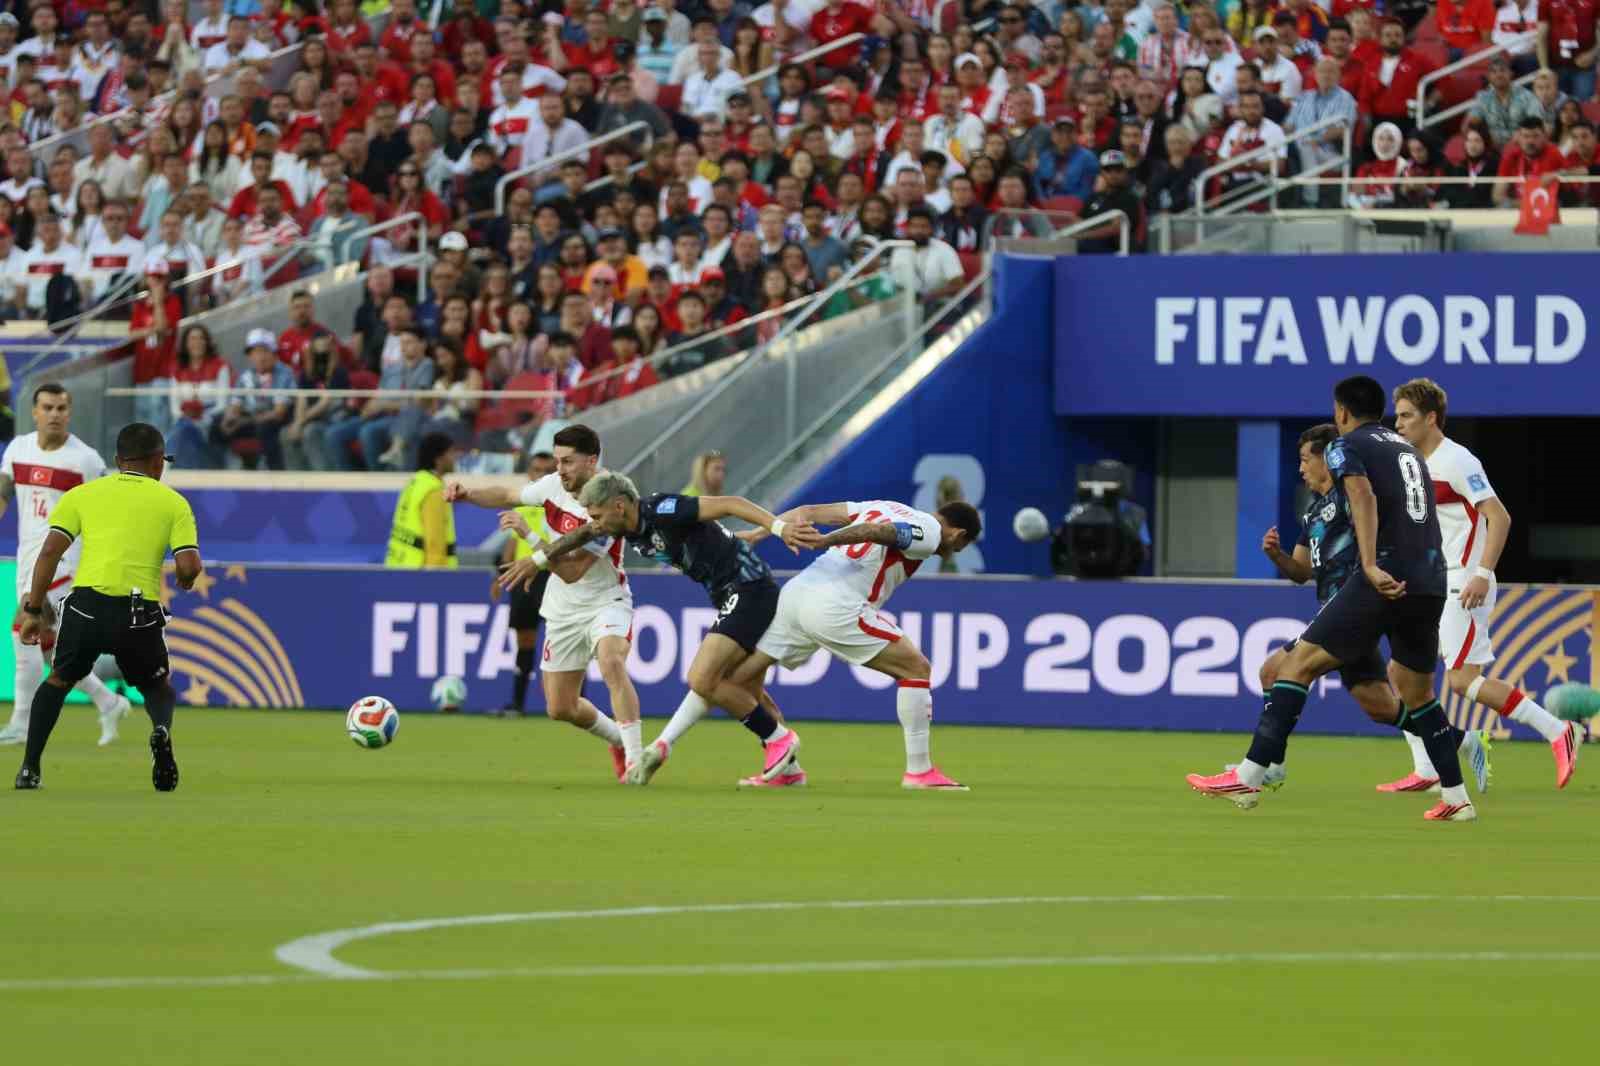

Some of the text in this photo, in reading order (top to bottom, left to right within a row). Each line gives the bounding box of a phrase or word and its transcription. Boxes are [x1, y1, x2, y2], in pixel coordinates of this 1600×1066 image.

[1155, 294, 1587, 365] FIFA WORLD
[33, 498, 48, 519] 14
[1398, 452, 1428, 523] 8
[372, 601, 537, 680] FIFA
